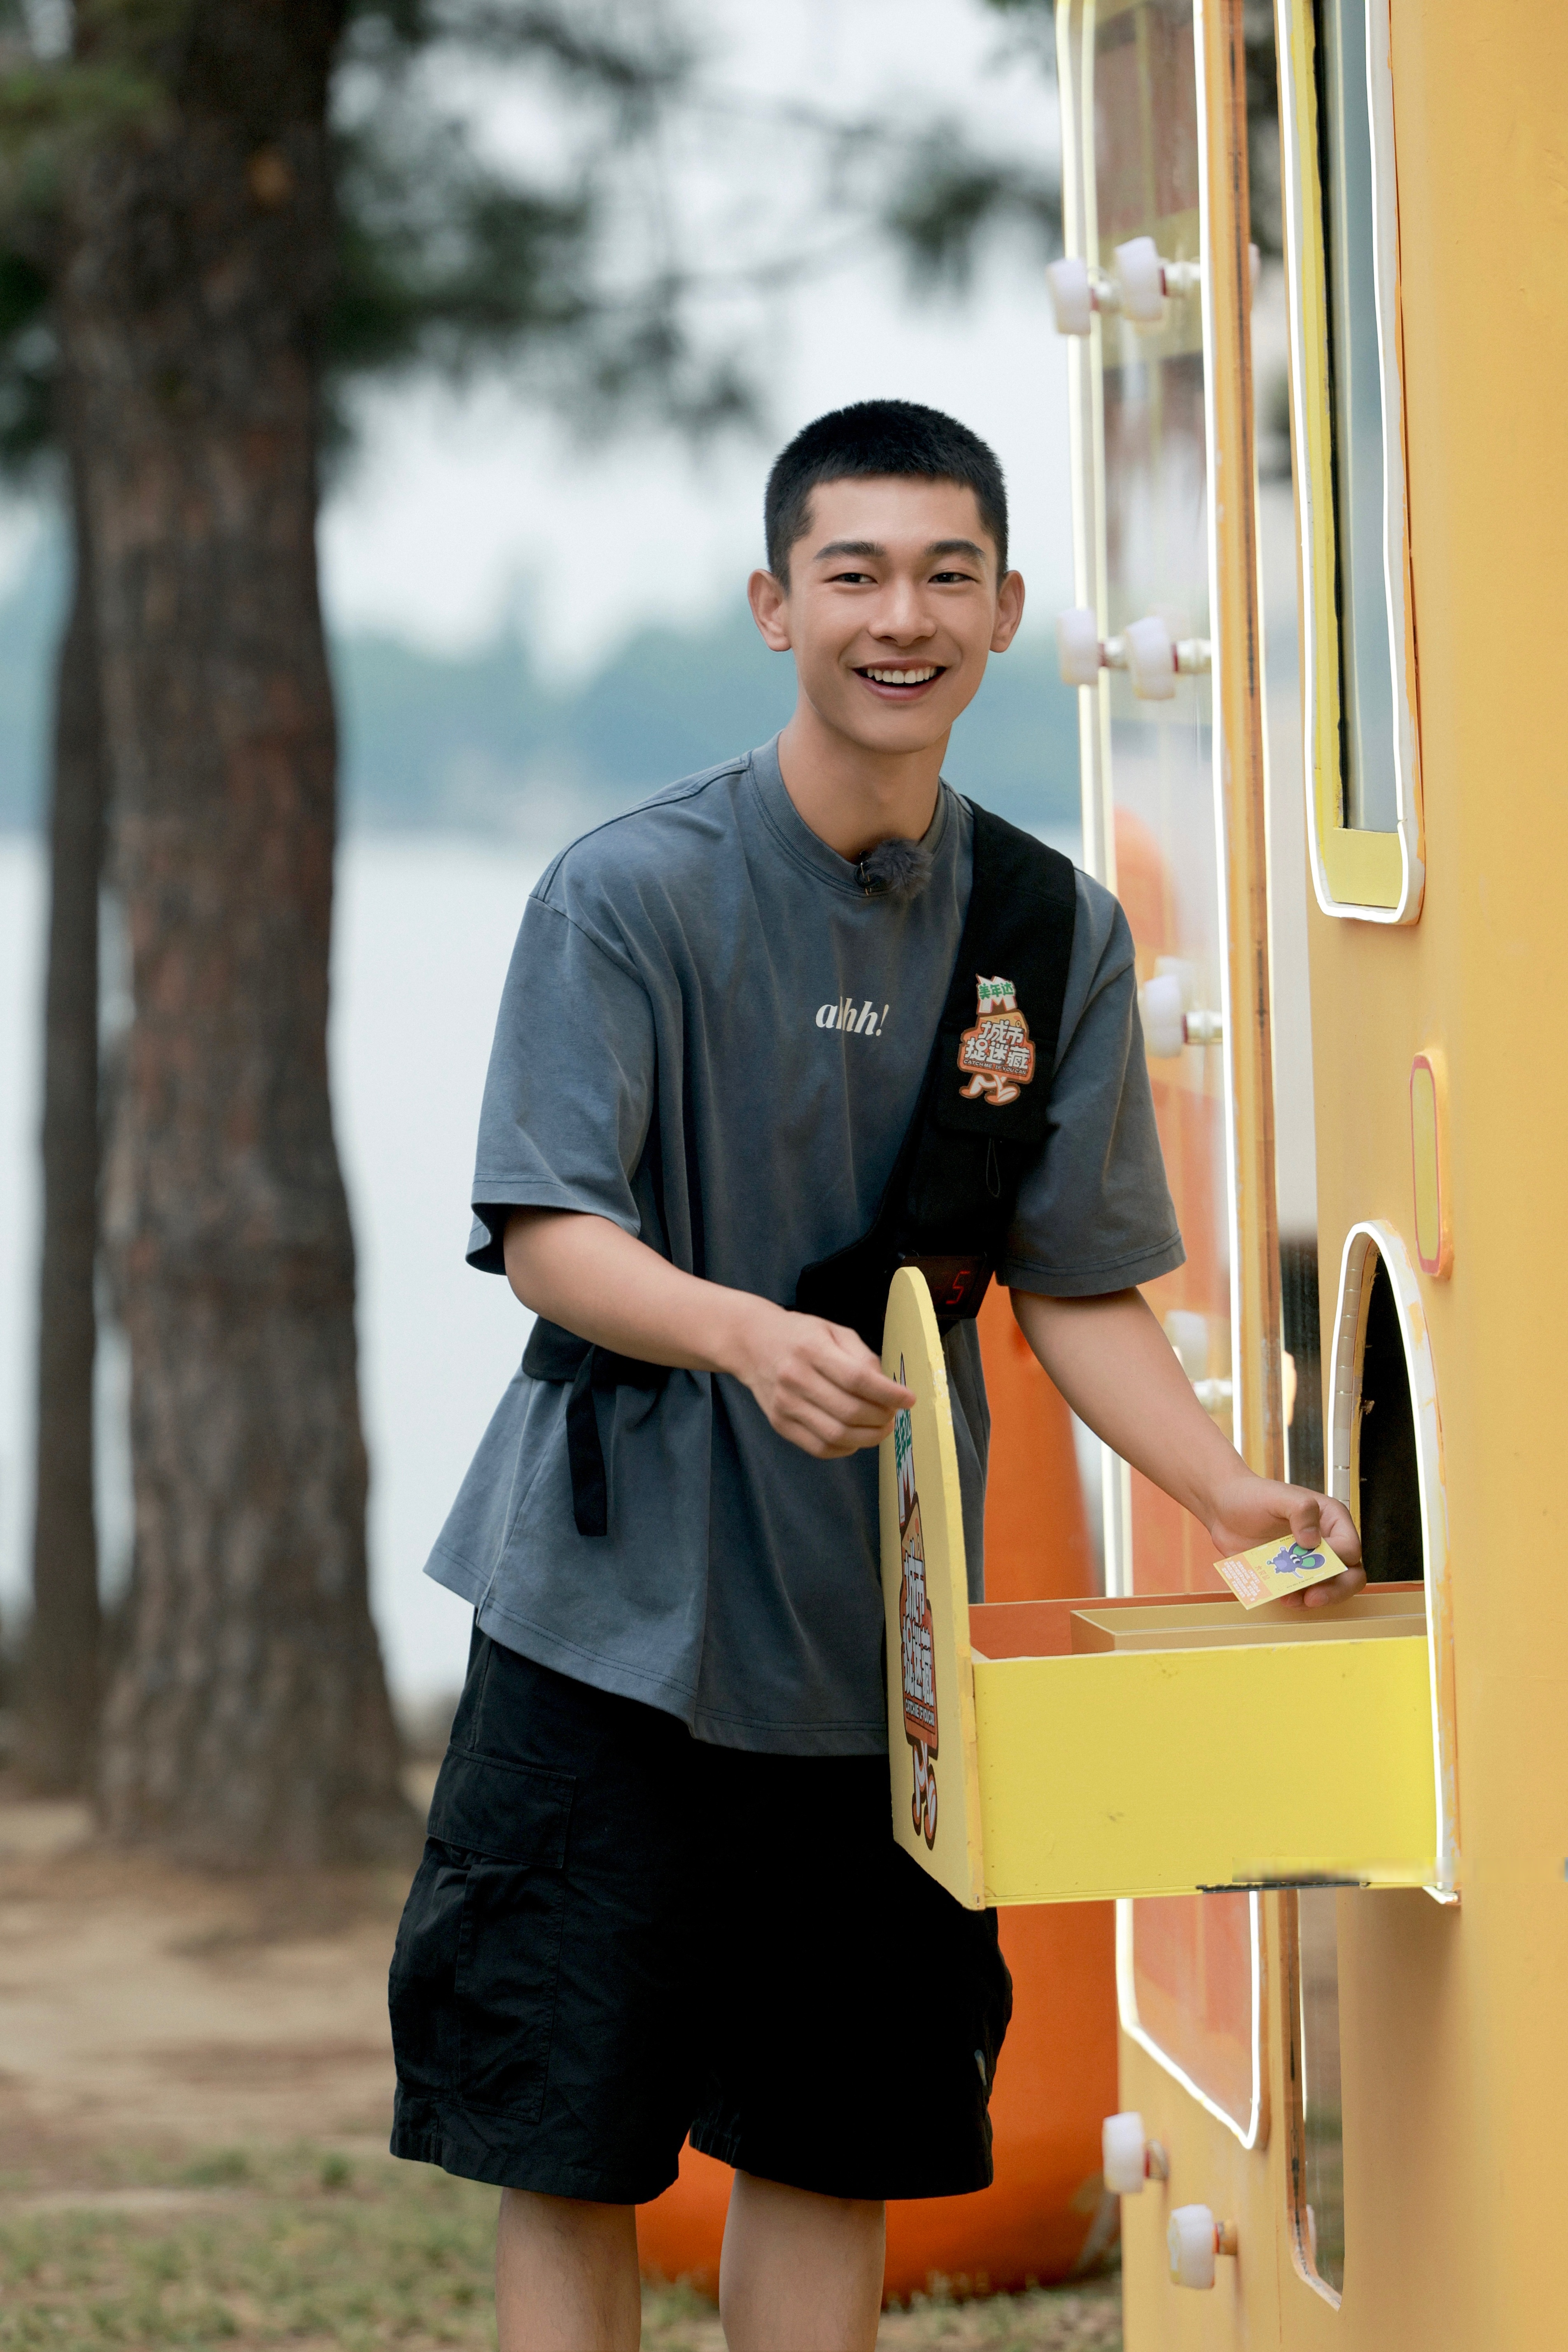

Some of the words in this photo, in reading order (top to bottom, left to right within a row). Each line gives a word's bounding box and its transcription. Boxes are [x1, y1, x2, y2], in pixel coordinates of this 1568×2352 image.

[979, 982, 1014, 1000] 美年达
[816, 996, 889, 1036] ahh!
[978, 1020, 1024, 1045] 城市
[964, 1037, 1030, 1069] 捉迷藏
[904, 1537, 925, 1625] 城市
[903, 1614, 934, 1707] 捉迷藏
[905, 1699, 915, 1715] CATCH
